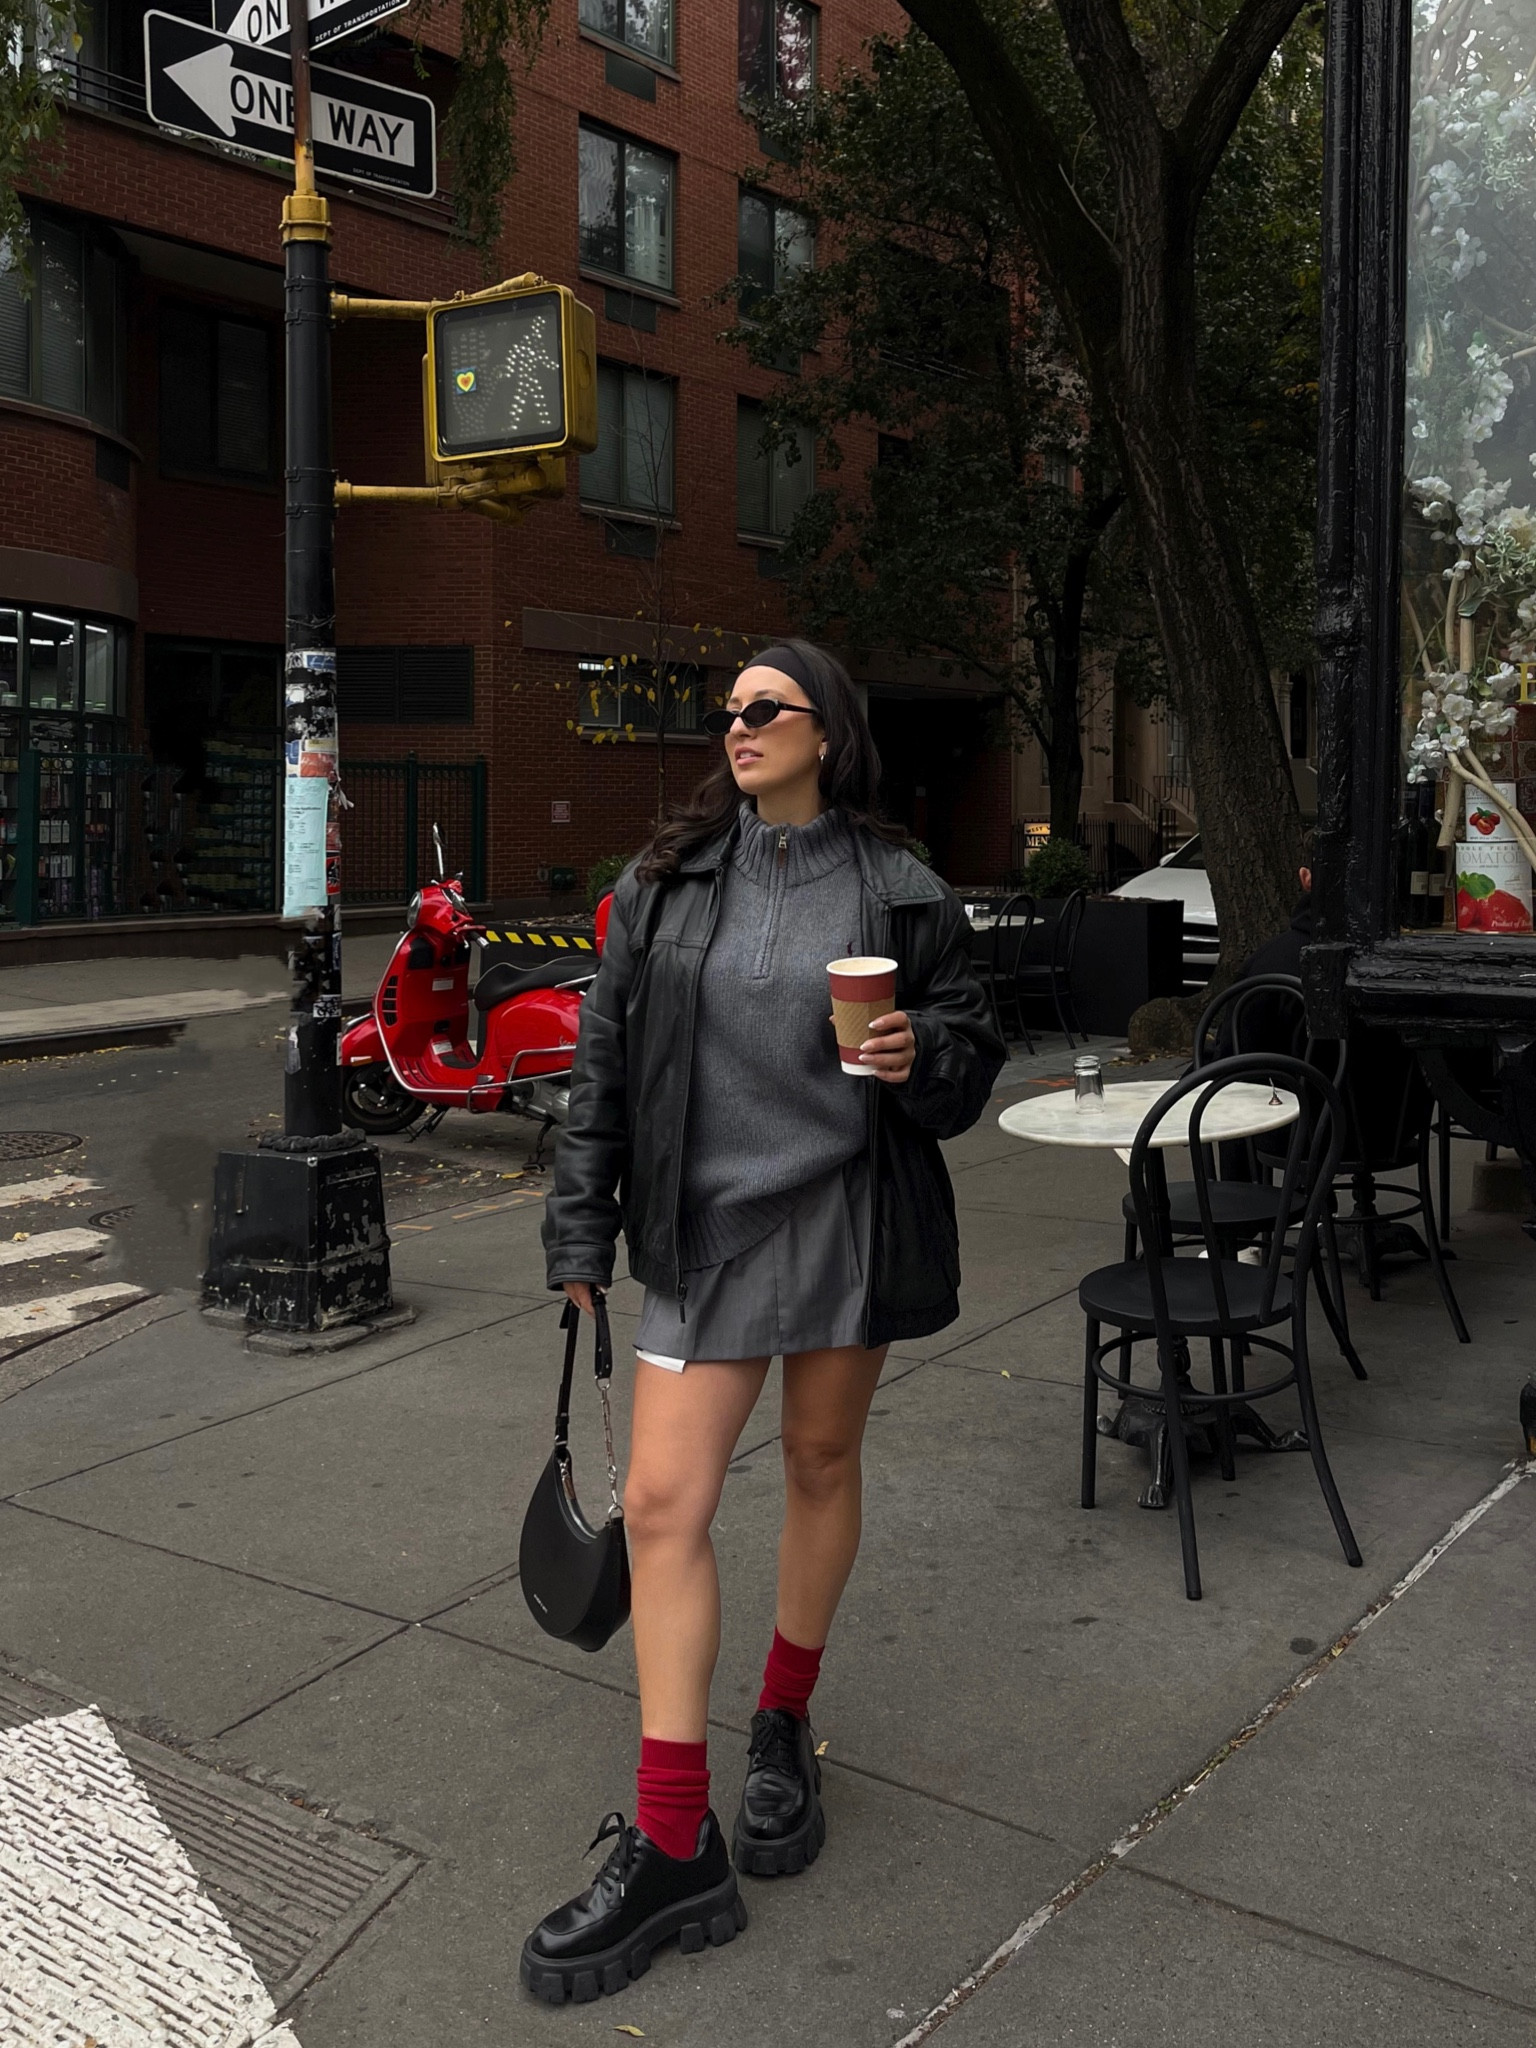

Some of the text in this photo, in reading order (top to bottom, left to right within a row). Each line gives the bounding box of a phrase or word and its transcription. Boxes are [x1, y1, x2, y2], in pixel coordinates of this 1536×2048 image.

[247, 0, 289, 43] ON
[314, 29, 332, 43] DEPT
[333, 24, 342, 34] OF
[343, 0, 401, 29] TRANSPORTATION
[328, 102, 405, 157] WAY
